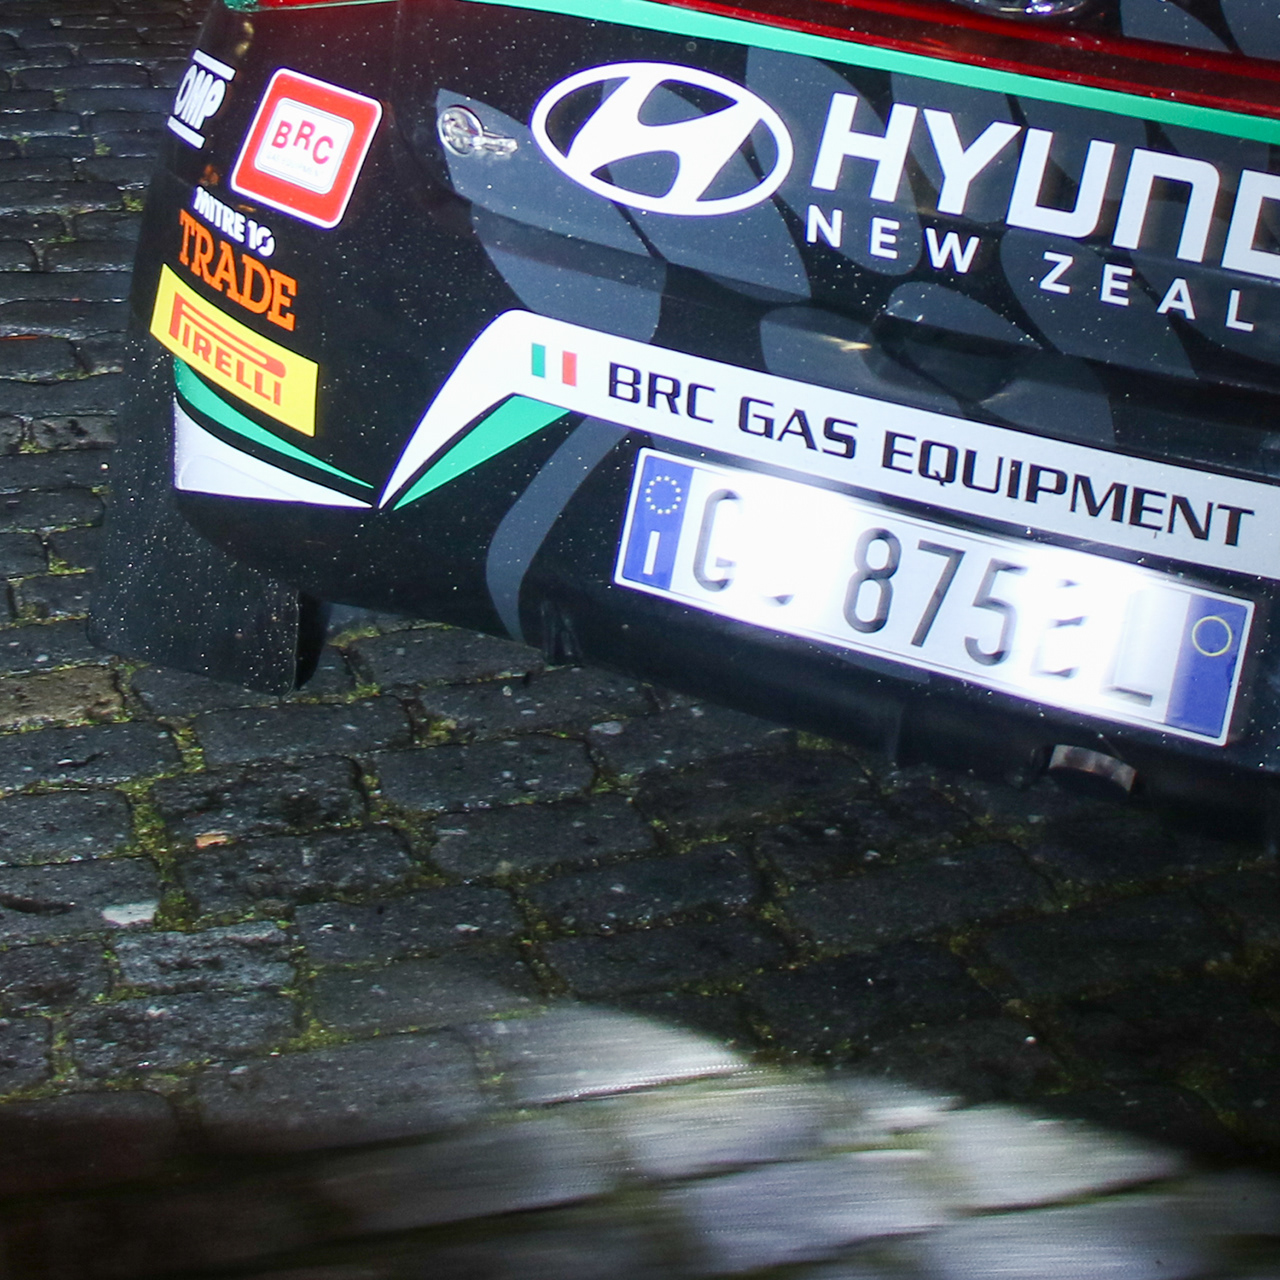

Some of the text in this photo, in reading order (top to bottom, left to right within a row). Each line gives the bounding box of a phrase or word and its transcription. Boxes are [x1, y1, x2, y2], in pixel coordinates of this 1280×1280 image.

[173, 64, 227, 131] OMP
[271, 120, 335, 165] BRC
[193, 185, 275, 257] MITRE 10
[806, 205, 980, 274] NEW
[178, 208, 298, 332] TRADE
[169, 291, 287, 407] PIRELLI
[608, 362, 1256, 548] BRC GAS EQUIPMENT
